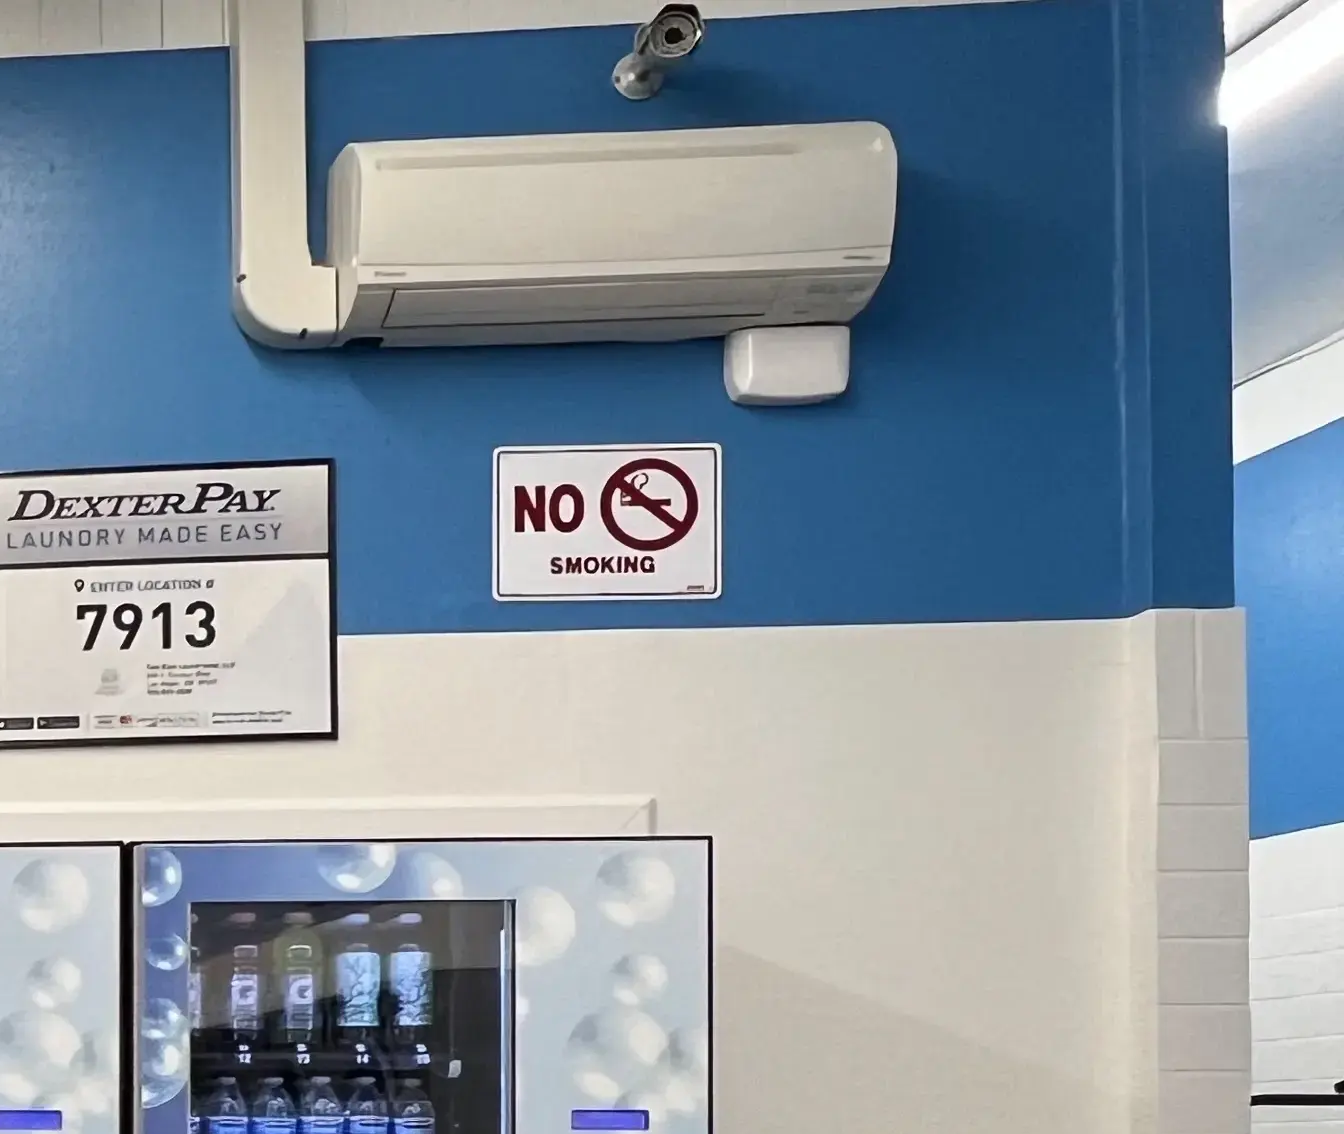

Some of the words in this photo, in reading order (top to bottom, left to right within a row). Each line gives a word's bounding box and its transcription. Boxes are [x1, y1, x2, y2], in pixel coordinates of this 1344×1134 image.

[514, 483, 585, 533] NO
[7, 527, 125, 550] LAUNDRY
[138, 525, 208, 544] MADE
[220, 522, 283, 541] EASY
[550, 556, 656, 575] SMOKING
[138, 579, 202, 592] LOCATION
[76, 600, 217, 652] 7913
